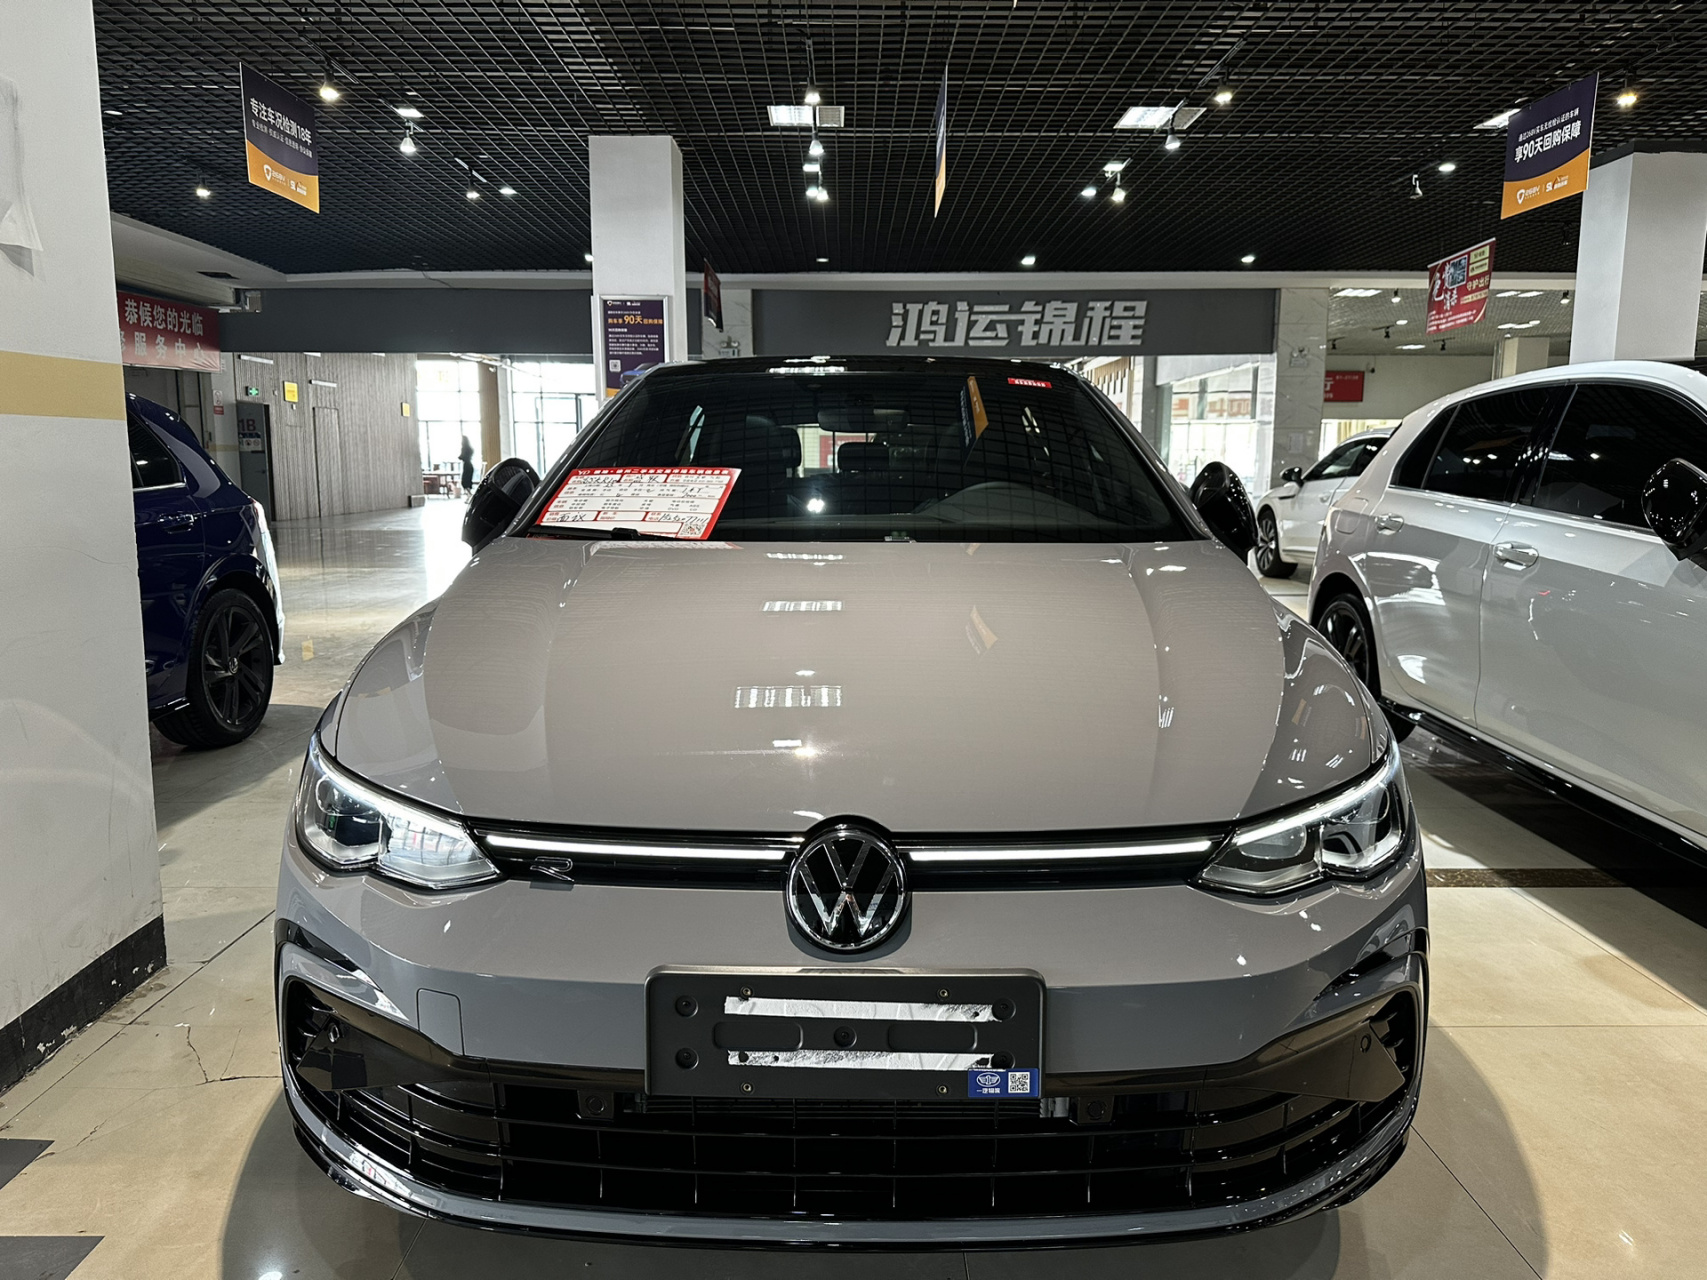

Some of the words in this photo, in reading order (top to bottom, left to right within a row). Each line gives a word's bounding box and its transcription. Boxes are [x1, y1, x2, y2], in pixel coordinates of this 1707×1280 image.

[250, 98, 312, 146] 专注车况检测18年
[1514, 120, 1582, 163] 享90天回购保障
[125, 298, 203, 336] 恭候您的光临
[886, 300, 1148, 346] 鸿运锦程
